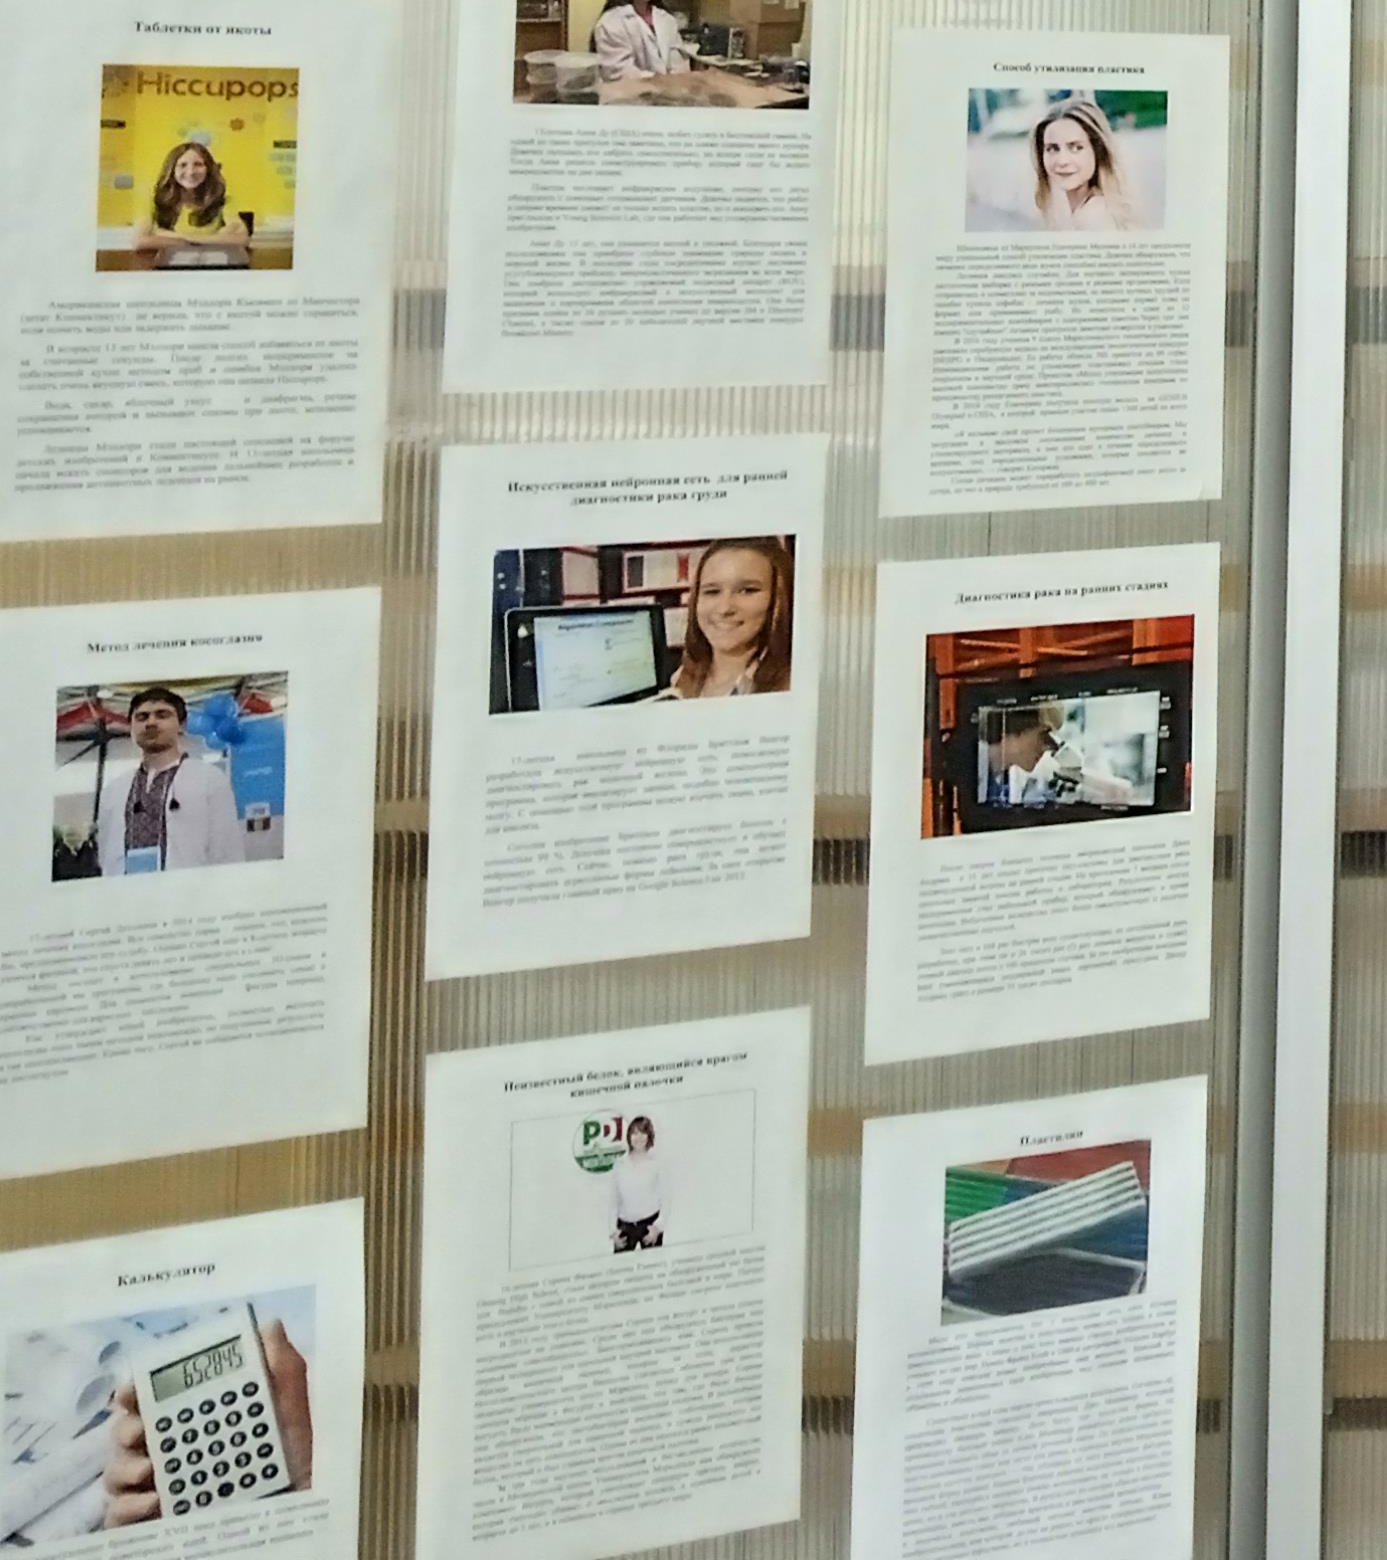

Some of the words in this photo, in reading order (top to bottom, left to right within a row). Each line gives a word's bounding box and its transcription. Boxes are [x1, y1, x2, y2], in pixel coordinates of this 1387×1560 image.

[135, 21, 202, 34] Таблетки
[206, 26, 220, 34] от
[226, 27, 271, 35] икоты
[136, 71, 298, 102] Hiccupops
[118, 1264, 215, 1287] Калькулятор
[183, 1344, 243, 1389] 652845
